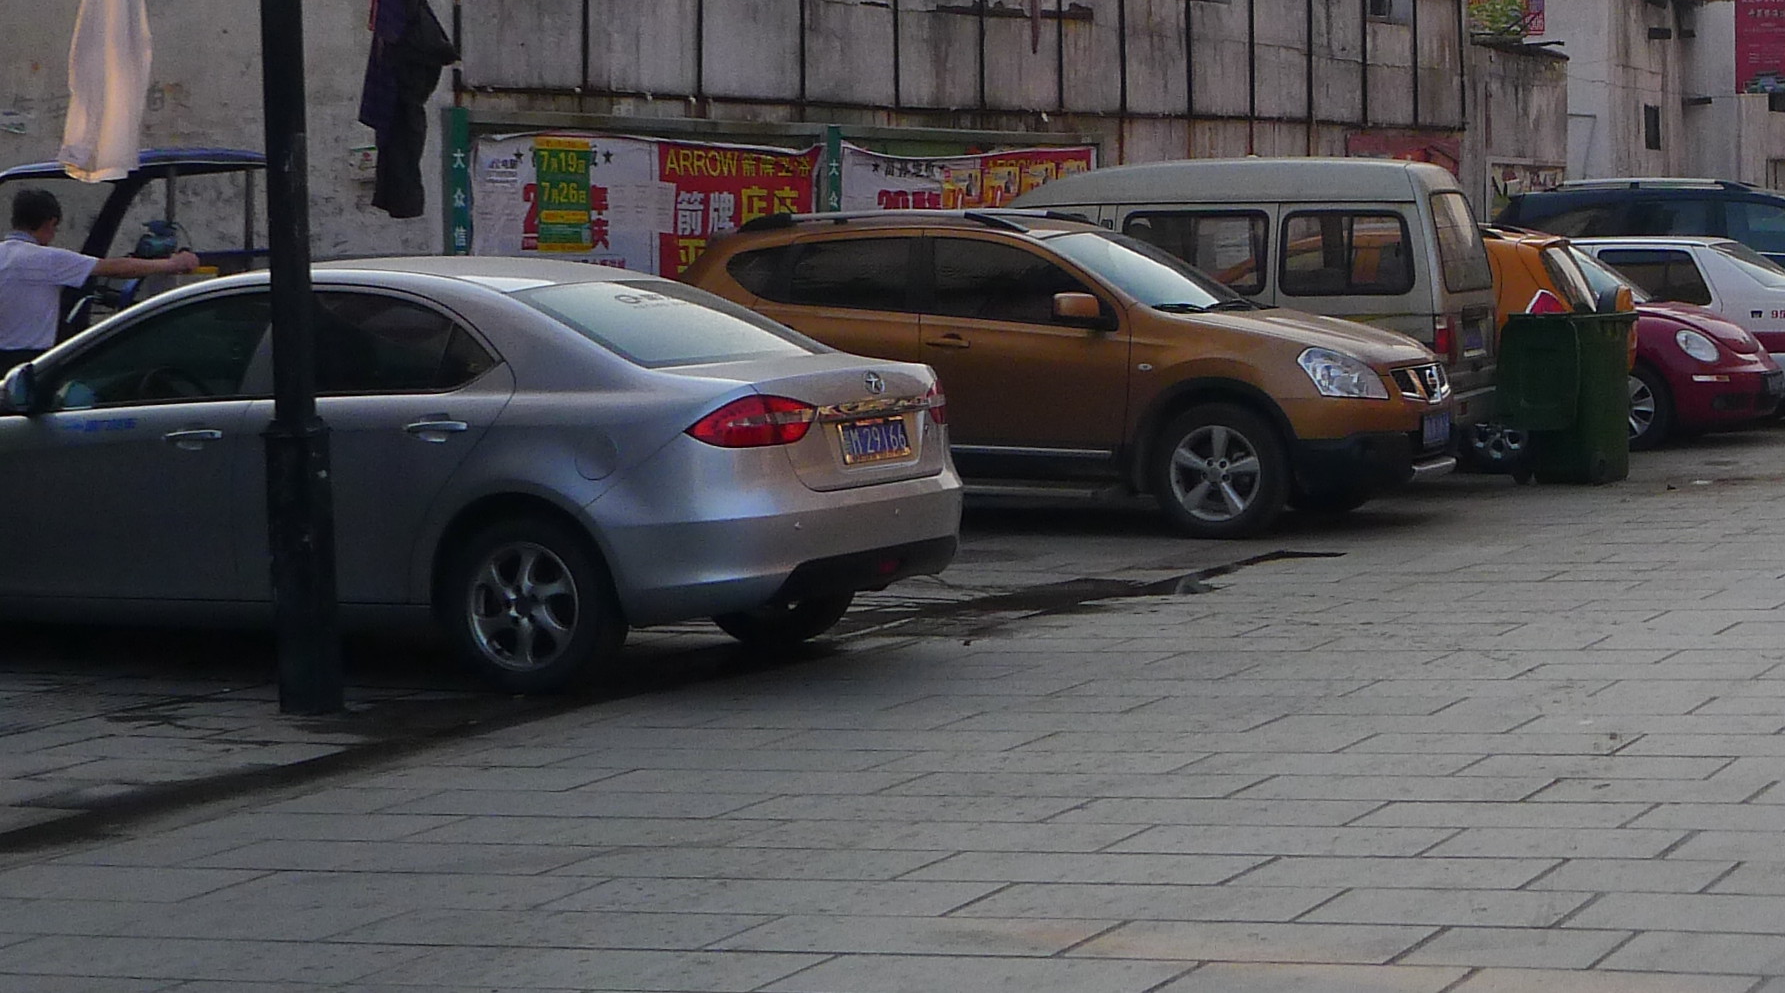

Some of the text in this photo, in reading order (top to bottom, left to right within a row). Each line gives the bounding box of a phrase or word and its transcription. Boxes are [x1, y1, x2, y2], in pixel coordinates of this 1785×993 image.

[665, 149, 738, 177] ARROW
[452, 148, 467, 254] 大众信
[541, 182, 587, 205] 7月26日
